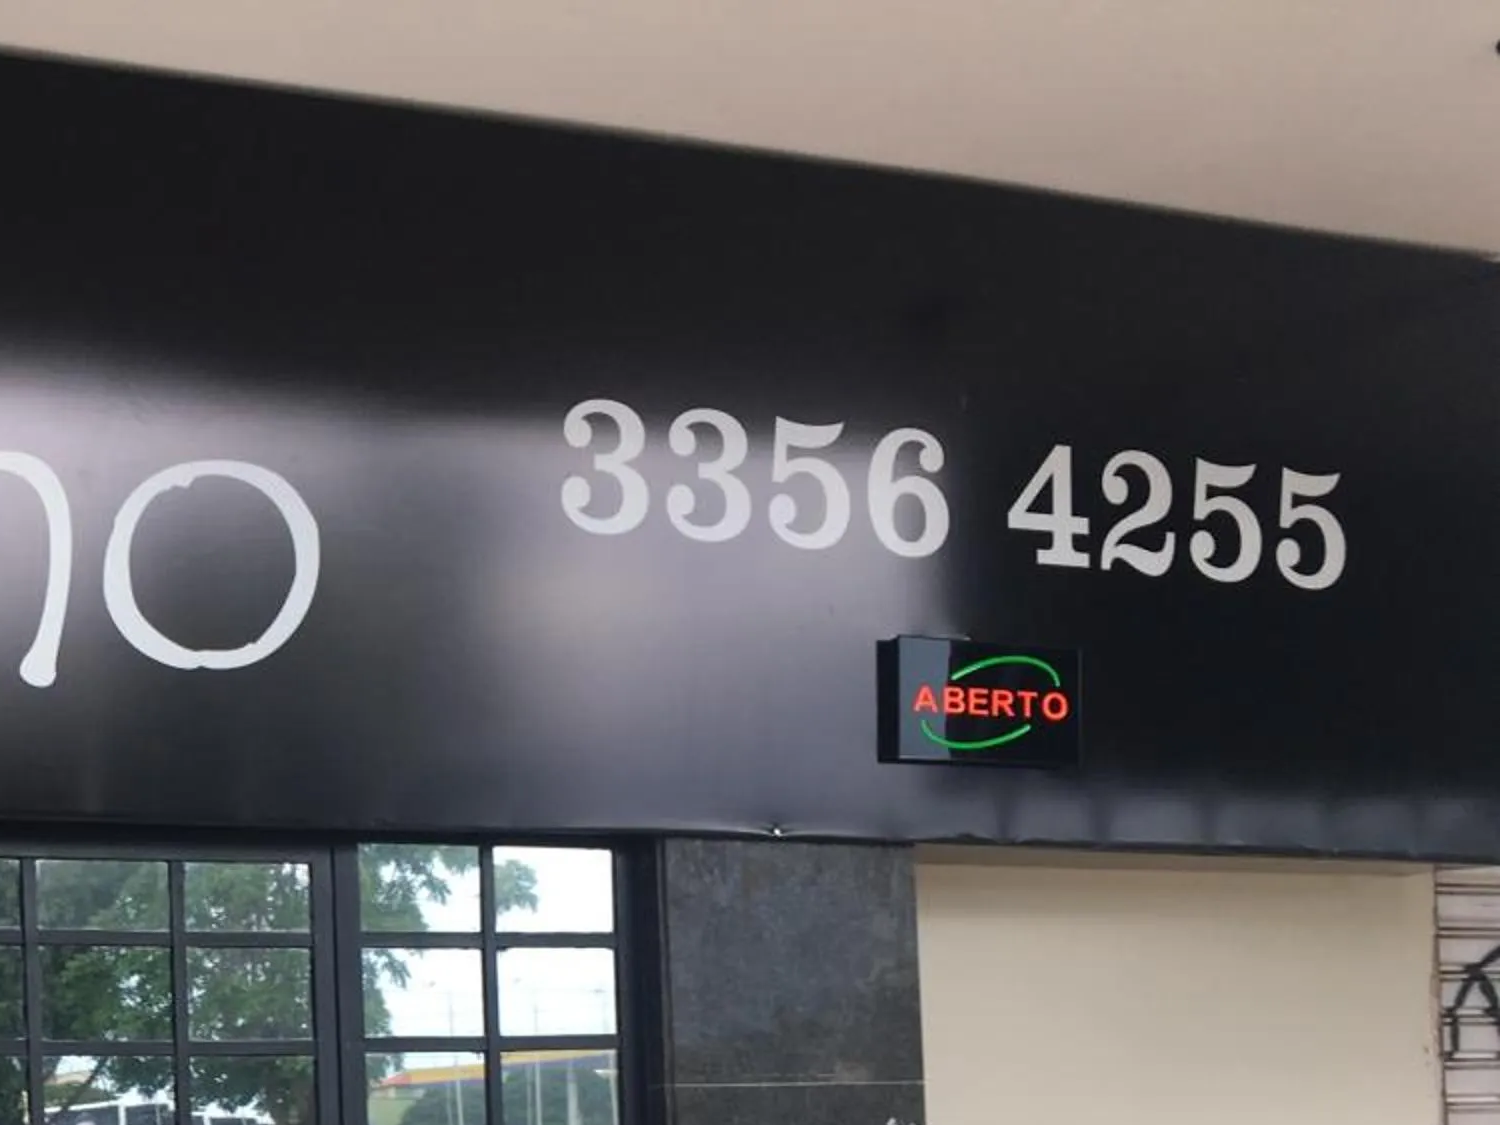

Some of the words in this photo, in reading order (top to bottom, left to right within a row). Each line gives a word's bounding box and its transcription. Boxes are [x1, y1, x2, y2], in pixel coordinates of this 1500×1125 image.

[560, 398, 950, 559] 3356
[1006, 444, 1347, 591] 4255
[913, 683, 1069, 721] ABERTO
